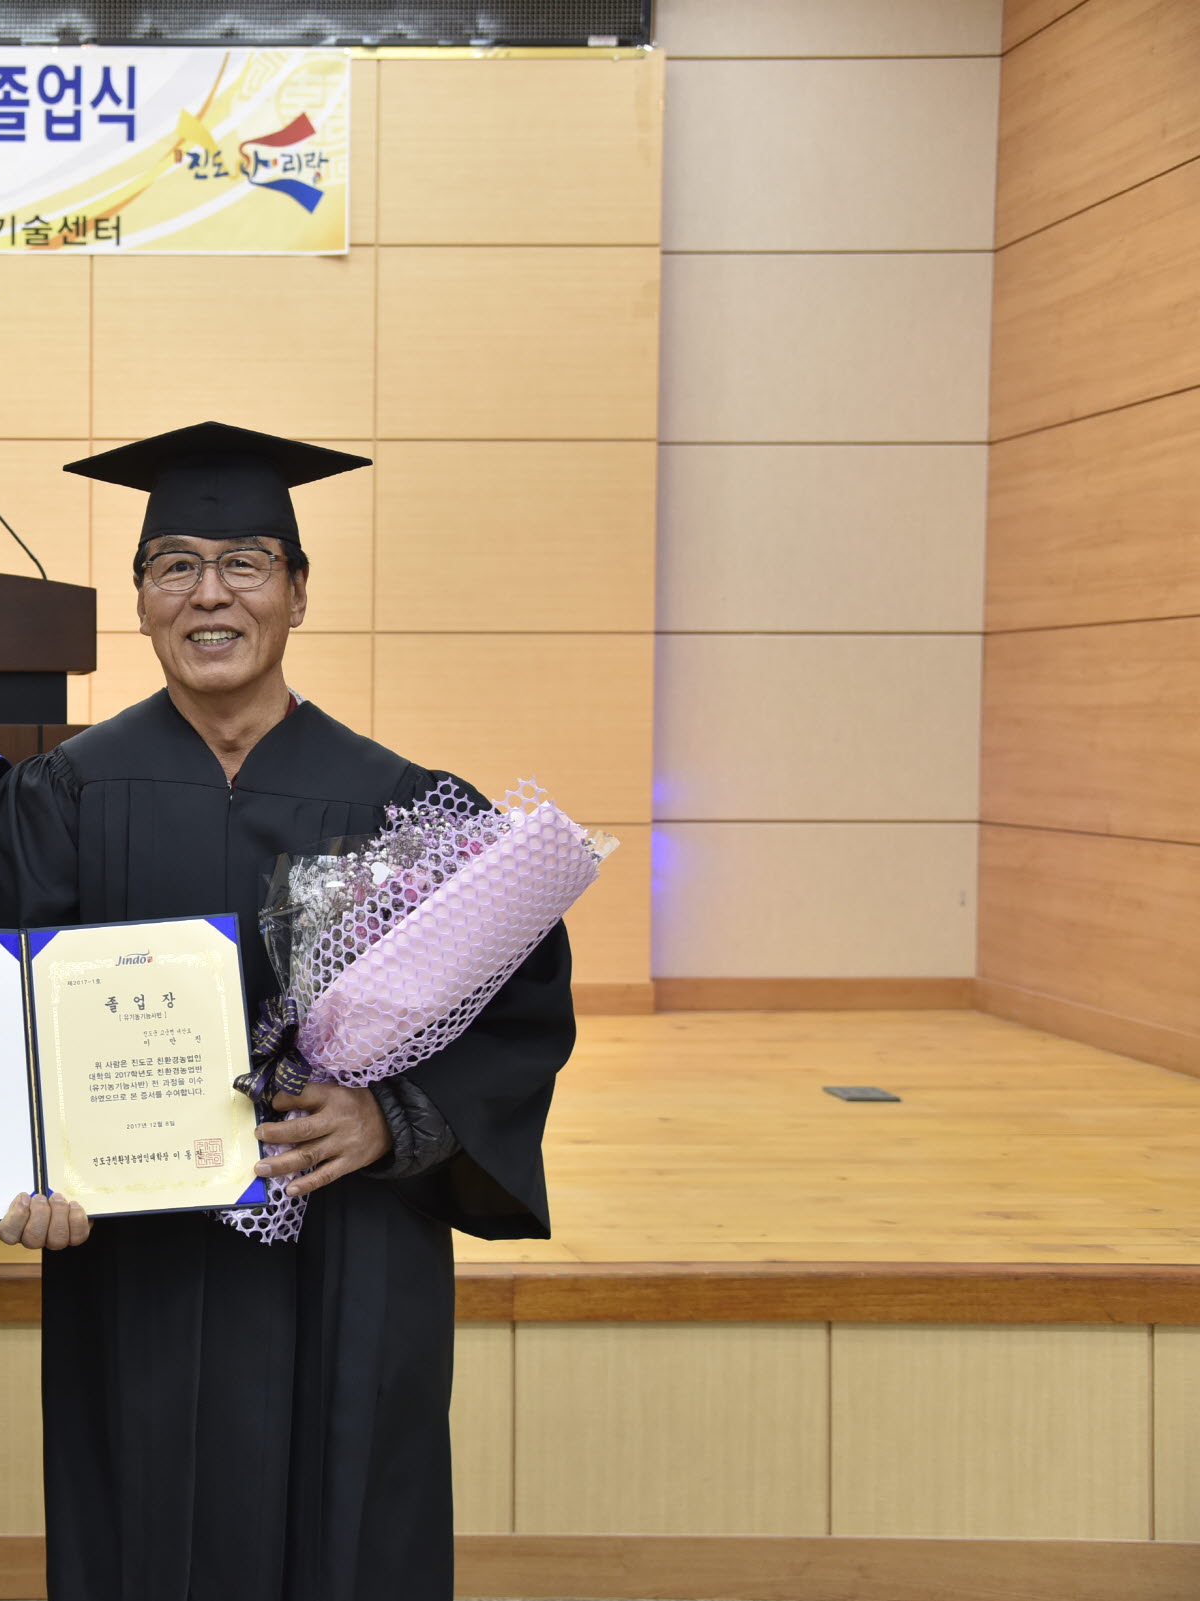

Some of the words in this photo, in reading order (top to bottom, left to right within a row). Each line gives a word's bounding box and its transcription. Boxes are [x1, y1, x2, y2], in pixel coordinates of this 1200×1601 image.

[115, 955, 147, 967] Jindo
[94, 1062, 102, 1070] 위
[106, 1060, 128, 1069] 사람은
[132, 1058, 154, 1068] 진도군
[157, 1055, 202, 1066] 친환경농업인
[89, 1072, 112, 1081] 대학의
[115, 1070, 154, 1079] 2017학년도
[157, 1064, 203, 1077] 친환경농업반
[90, 1081, 149, 1093] (유기농기능사반)
[163, 1078, 185, 1087] 과정을
[189, 1077, 204, 1085] 이수
[91, 1094, 128, 1103] 하였으므로
[141, 1091, 163, 1101] 증서를
[166, 1088, 205, 1098] 수여합니다.
